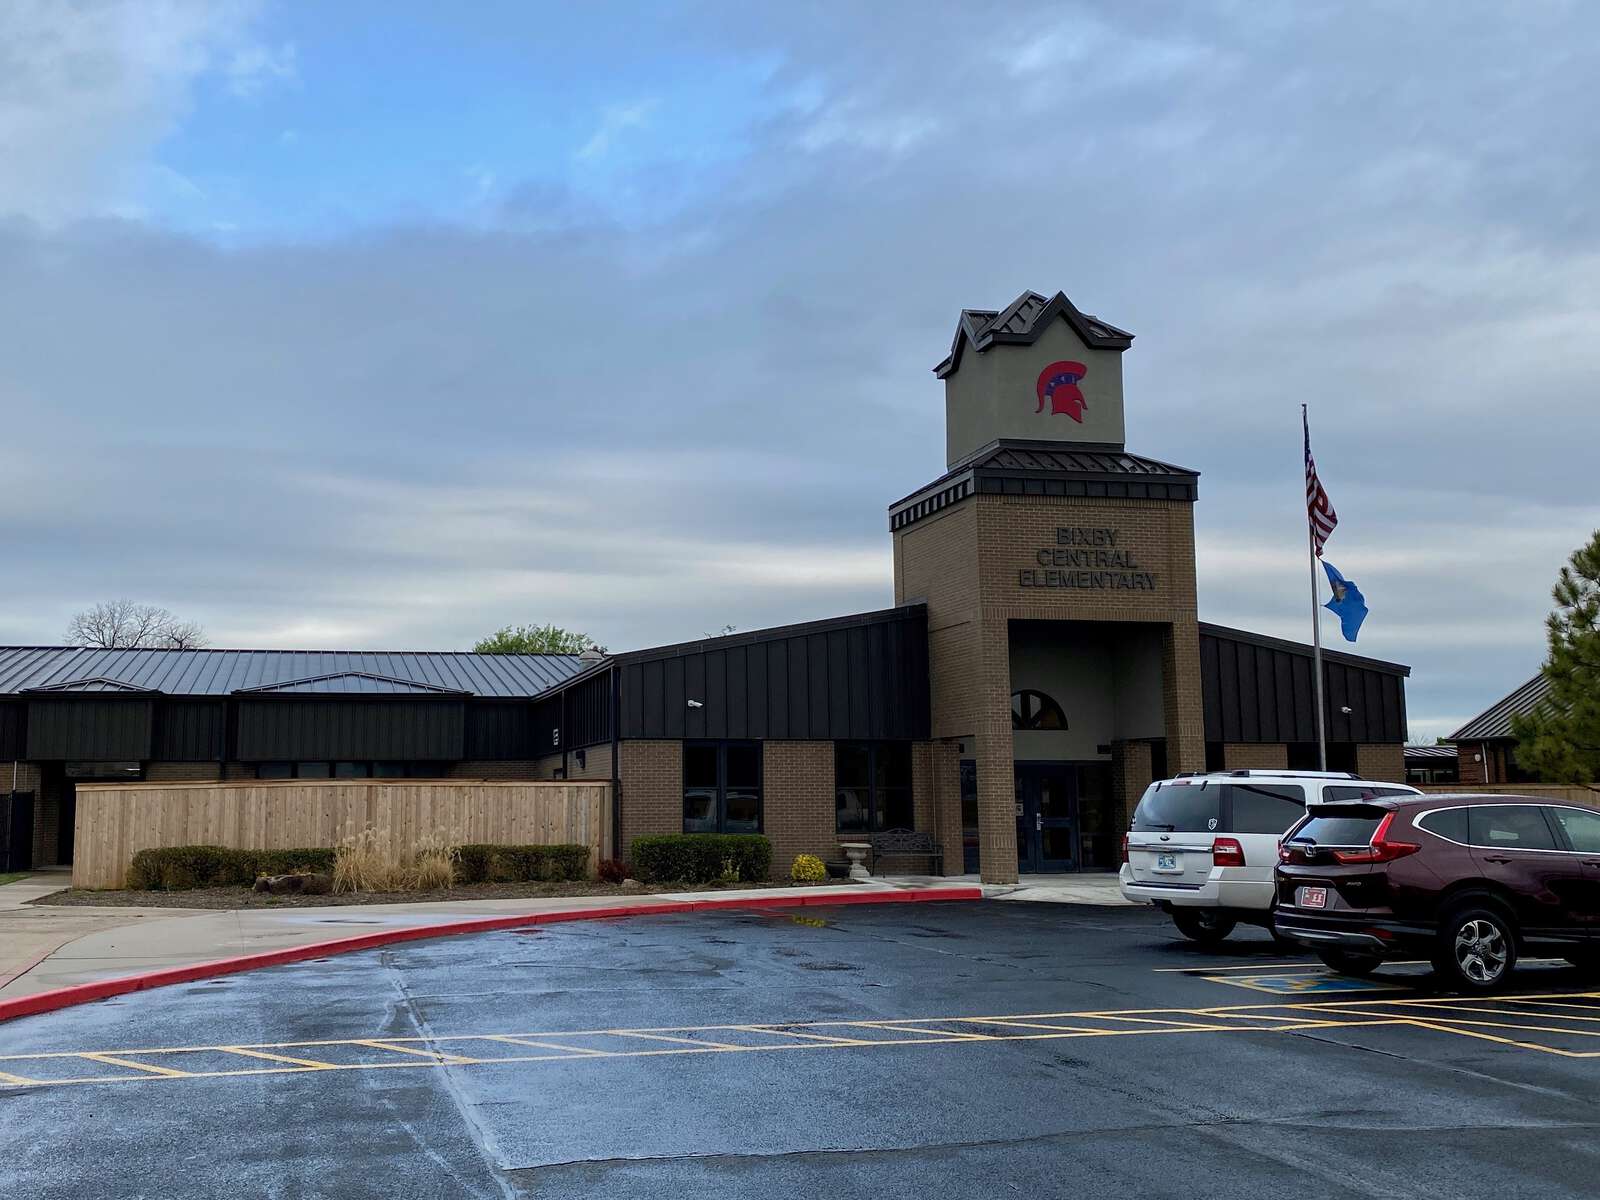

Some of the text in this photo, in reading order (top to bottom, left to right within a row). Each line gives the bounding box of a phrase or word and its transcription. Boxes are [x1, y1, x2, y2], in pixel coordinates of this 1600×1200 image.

[1057, 527, 1118, 546] BIXBY
[1037, 548, 1138, 568] CENTRAL
[1019, 569, 1157, 590] ELEMENTARY
